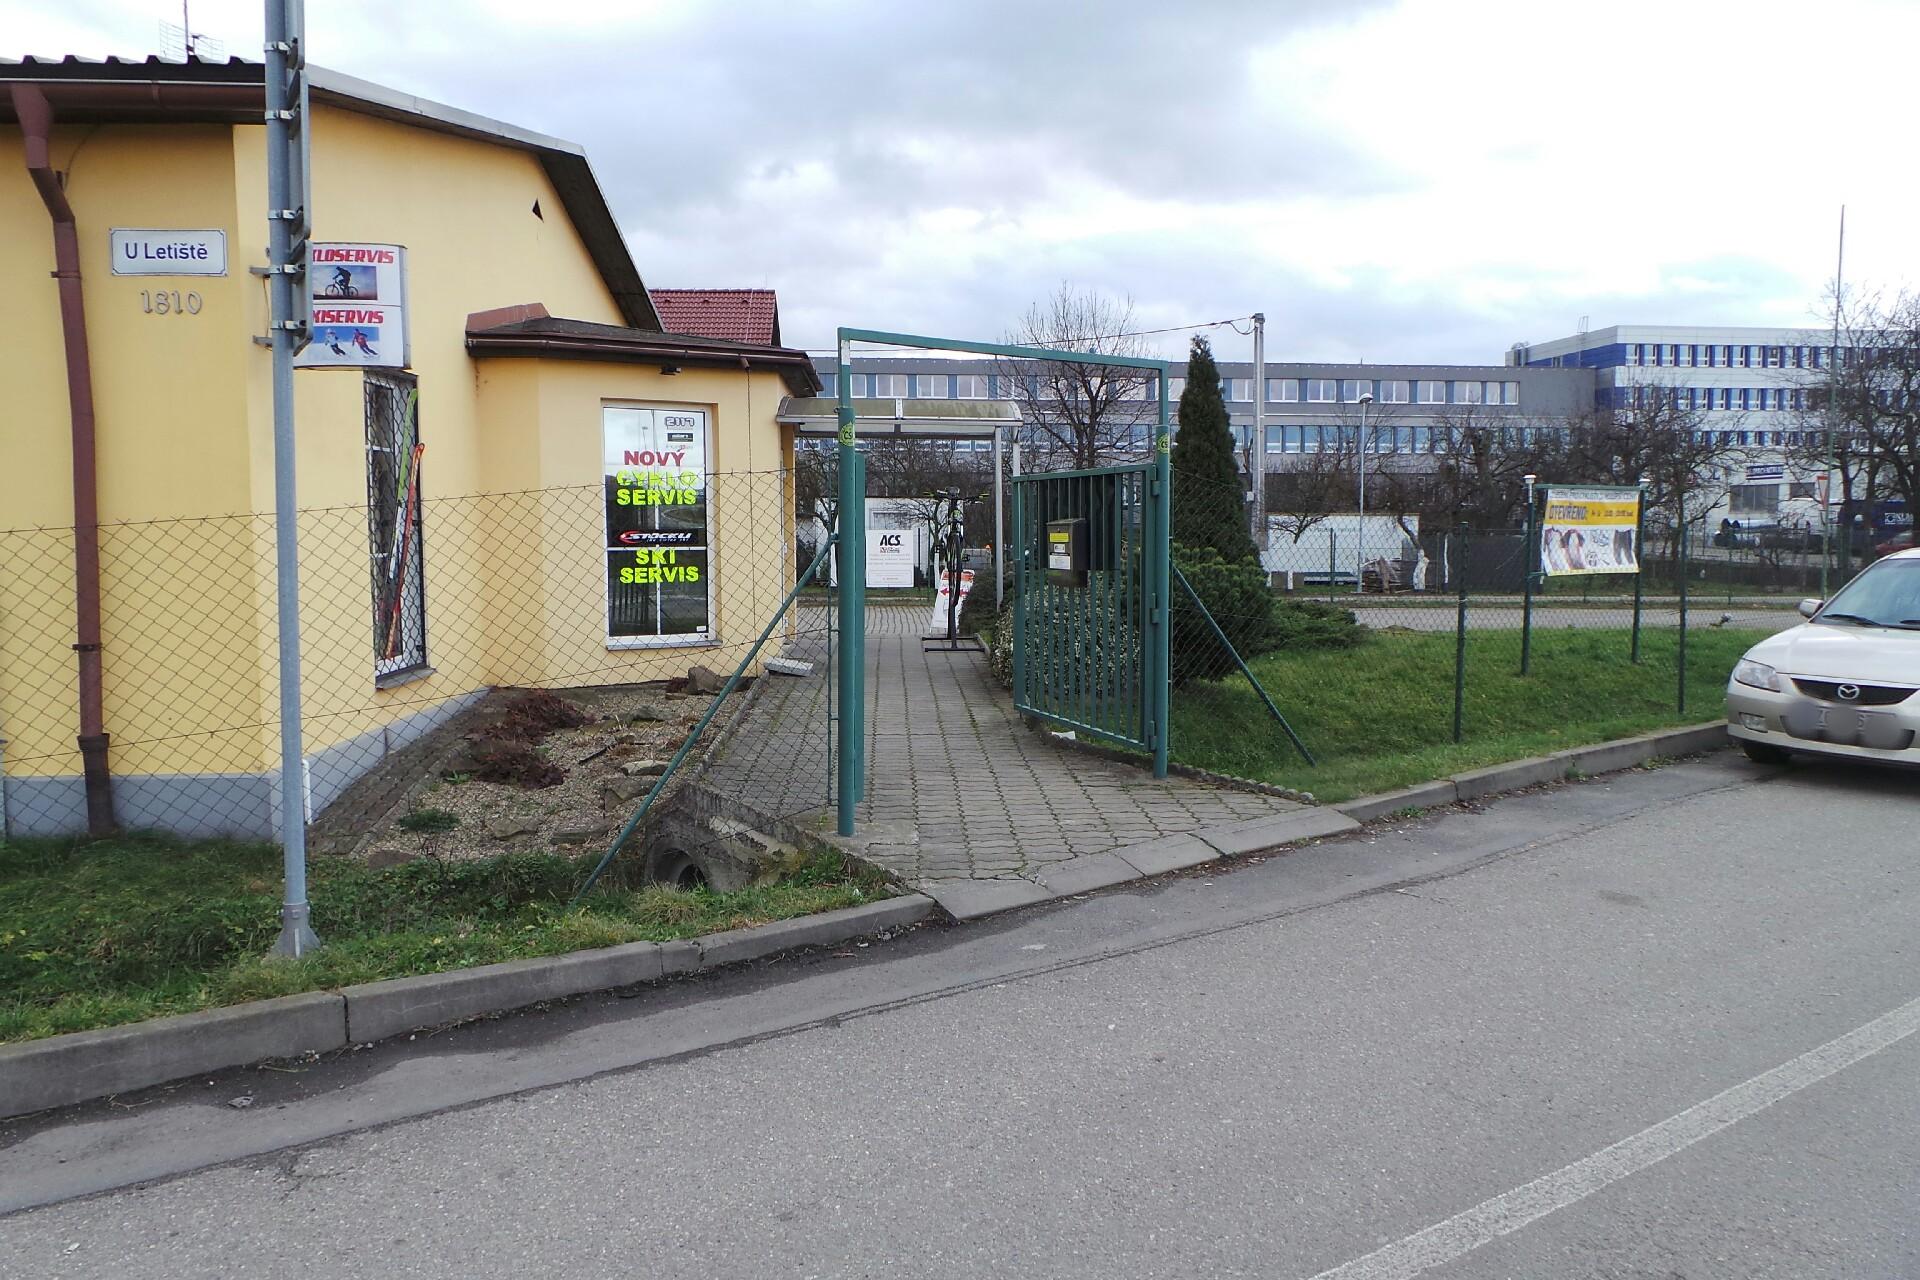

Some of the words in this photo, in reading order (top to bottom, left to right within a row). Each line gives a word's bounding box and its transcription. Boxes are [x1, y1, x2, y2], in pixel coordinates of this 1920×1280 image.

[124, 242, 139, 260] U
[144, 241, 209, 261] Letiště
[140, 289, 203, 316] 1810
[623, 448, 686, 467] NOVÝ
[616, 469, 698, 487] CYKLO
[616, 488, 698, 506] SERVIS
[879, 534, 902, 547] ACS
[635, 547, 677, 565] SKI
[619, 566, 700, 584] SERVIS
